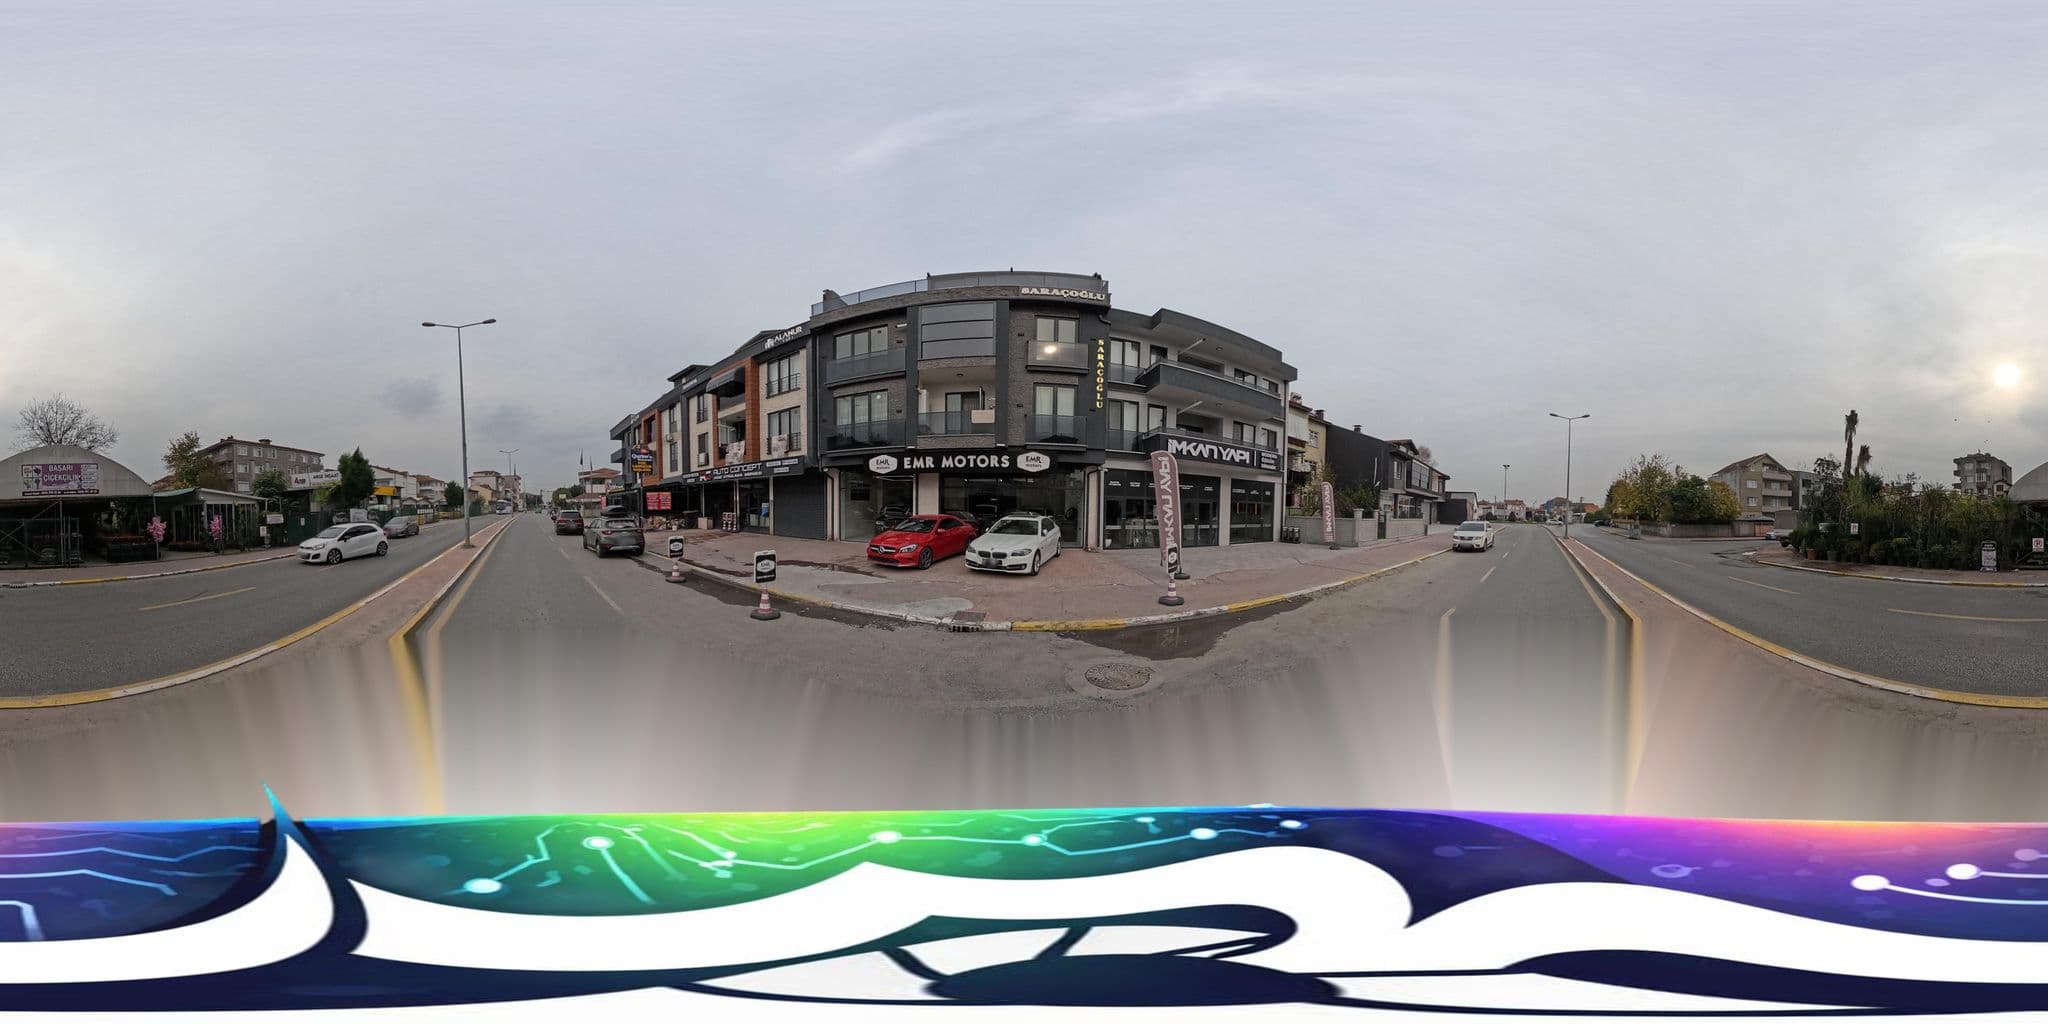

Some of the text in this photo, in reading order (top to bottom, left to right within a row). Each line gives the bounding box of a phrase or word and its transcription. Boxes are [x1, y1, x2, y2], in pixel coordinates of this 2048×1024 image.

[1021, 287, 1106, 301] SARAÇOĞLU
[1096, 339, 1105, 409] SARAÇOĞLU
[904, 455, 1010, 469] EMR MOTORS
[1026, 456, 1042, 464] EMR
[1219, 446, 1250, 464] YAPI
[713, 467, 729, 476] AUTO
[730, 463, 762, 473] CONCEPT
